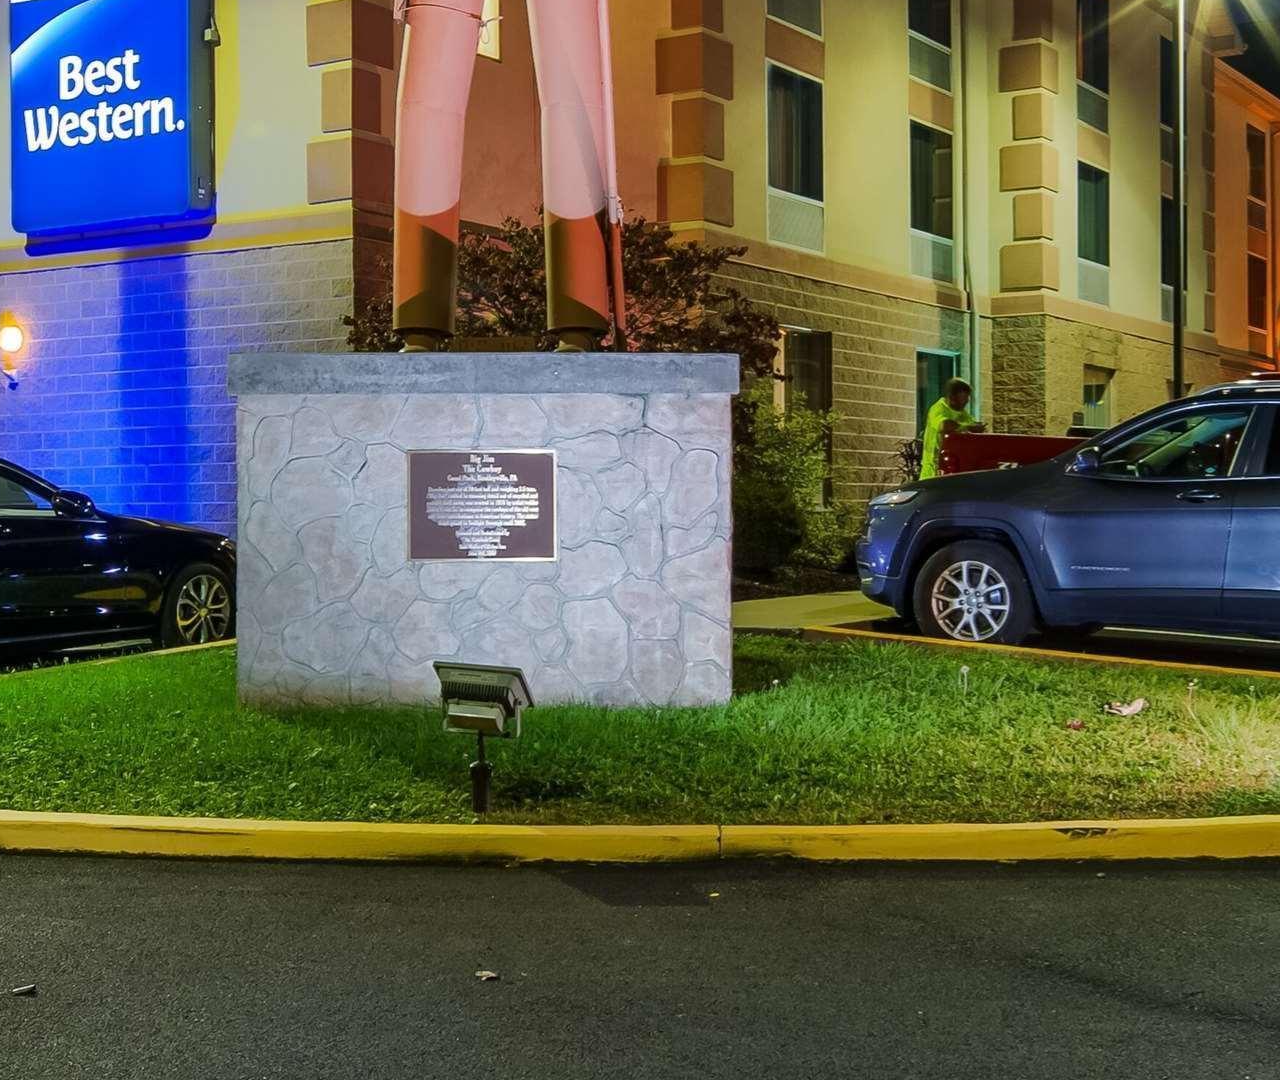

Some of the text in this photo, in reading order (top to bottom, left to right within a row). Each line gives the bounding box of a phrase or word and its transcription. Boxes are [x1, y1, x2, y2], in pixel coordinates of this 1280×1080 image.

[59, 49, 141, 100] Best
[462, 464, 502, 474] The Cowboy
